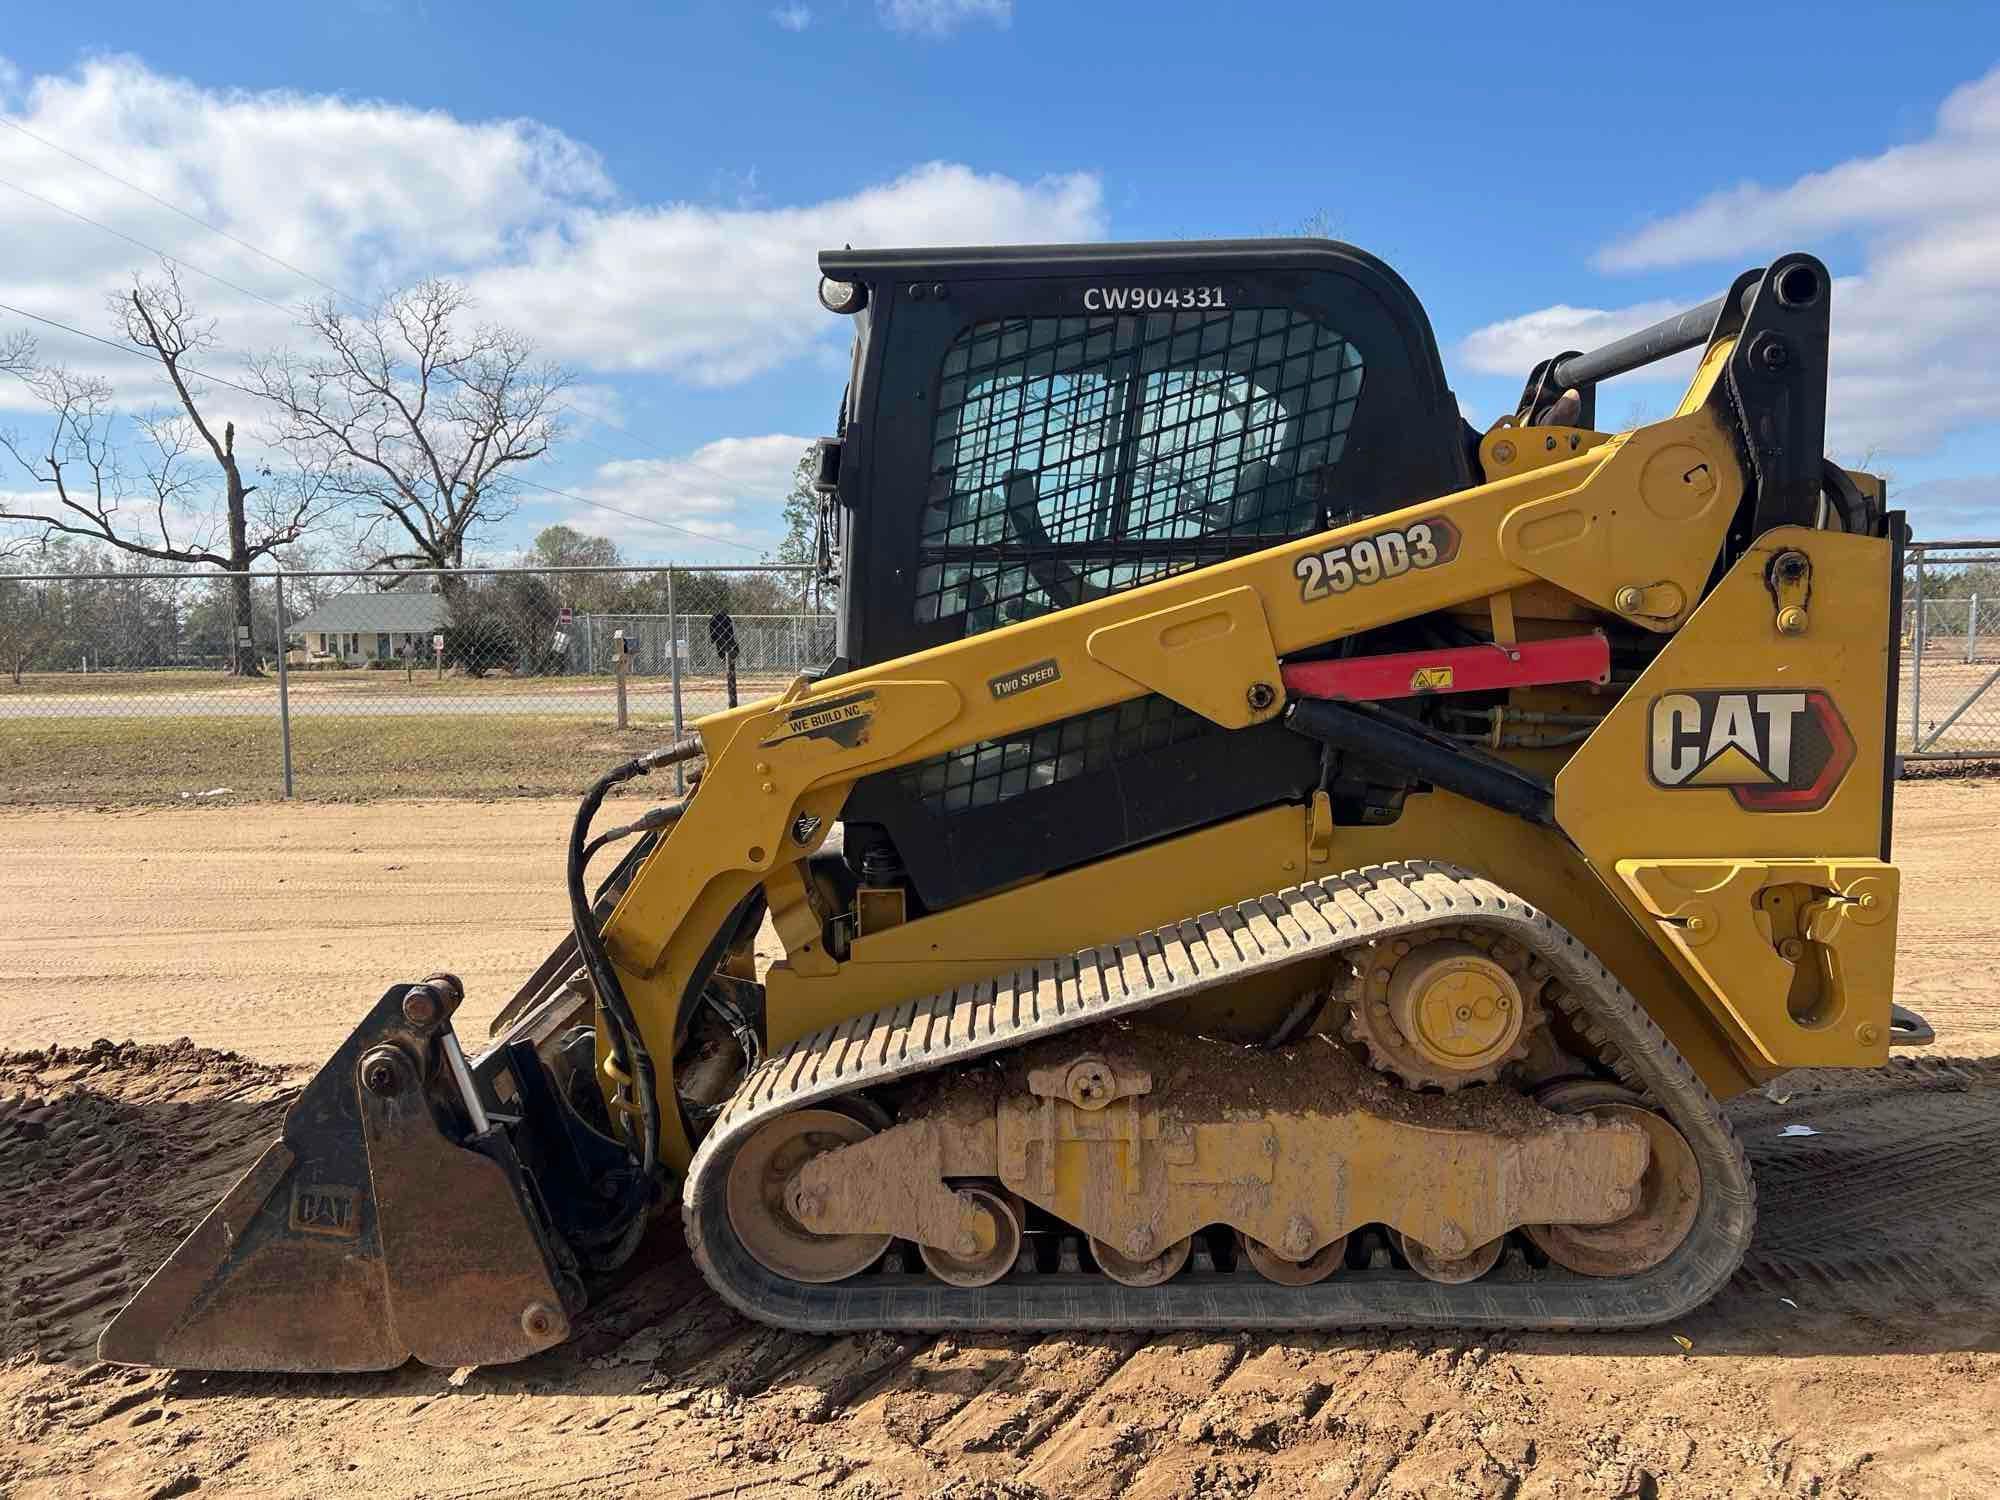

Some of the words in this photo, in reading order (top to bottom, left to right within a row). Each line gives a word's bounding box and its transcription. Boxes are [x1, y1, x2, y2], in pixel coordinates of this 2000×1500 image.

[1083, 286, 1226, 310] CW904331
[1296, 524, 1437, 600] 259D3
[790, 721, 809, 732] WE
[811, 709, 842, 727] BUILD
[844, 704, 860, 717] NC
[1652, 693, 1806, 784] CAT
